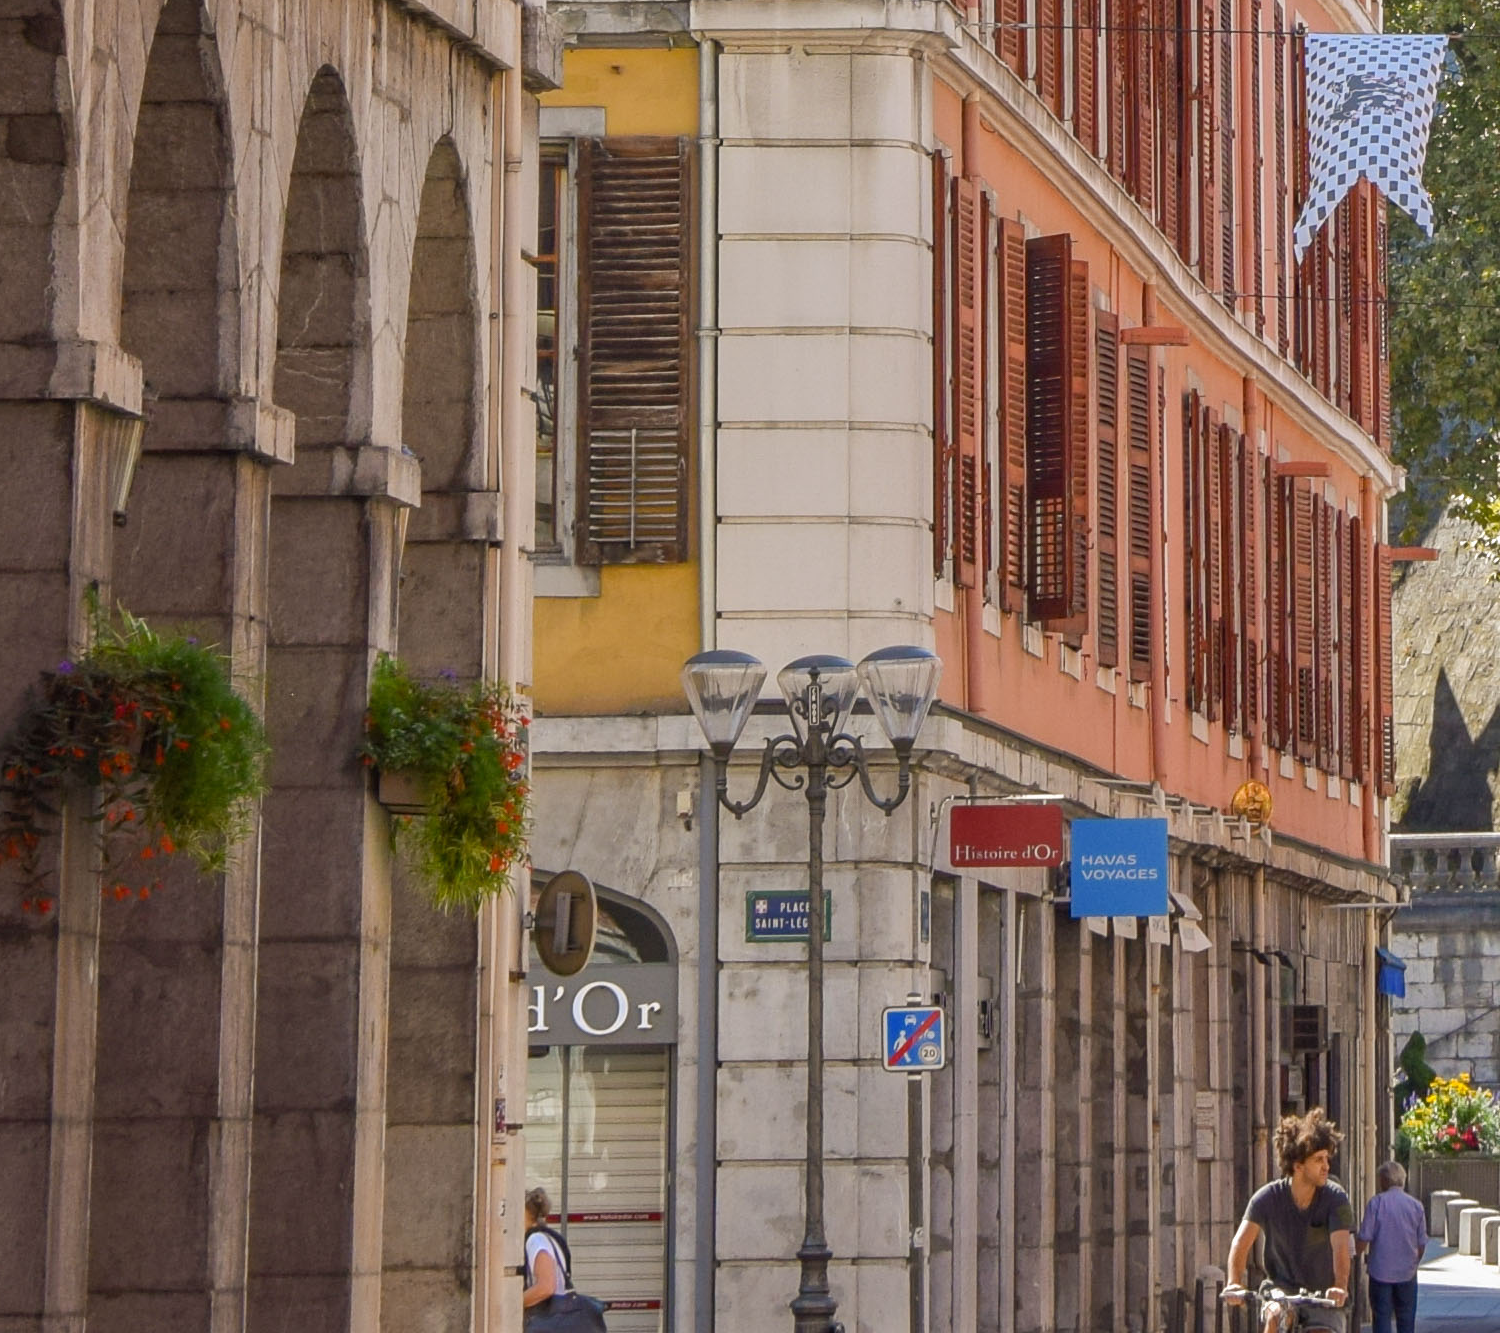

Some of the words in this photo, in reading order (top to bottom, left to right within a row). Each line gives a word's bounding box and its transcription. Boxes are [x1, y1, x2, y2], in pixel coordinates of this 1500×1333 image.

[954, 844, 1018, 861] Histoire
[1022, 844, 1059, 861] d'Or
[1081, 854, 1137, 866] HAVAS
[1081, 868, 1158, 880] VOYAGES
[780, 901, 810, 913] PLACE
[755, 916, 809, 929] SAINT-LÉG
[528, 981, 661, 1035] d'Or
[923, 1048, 936, 1058] 20
